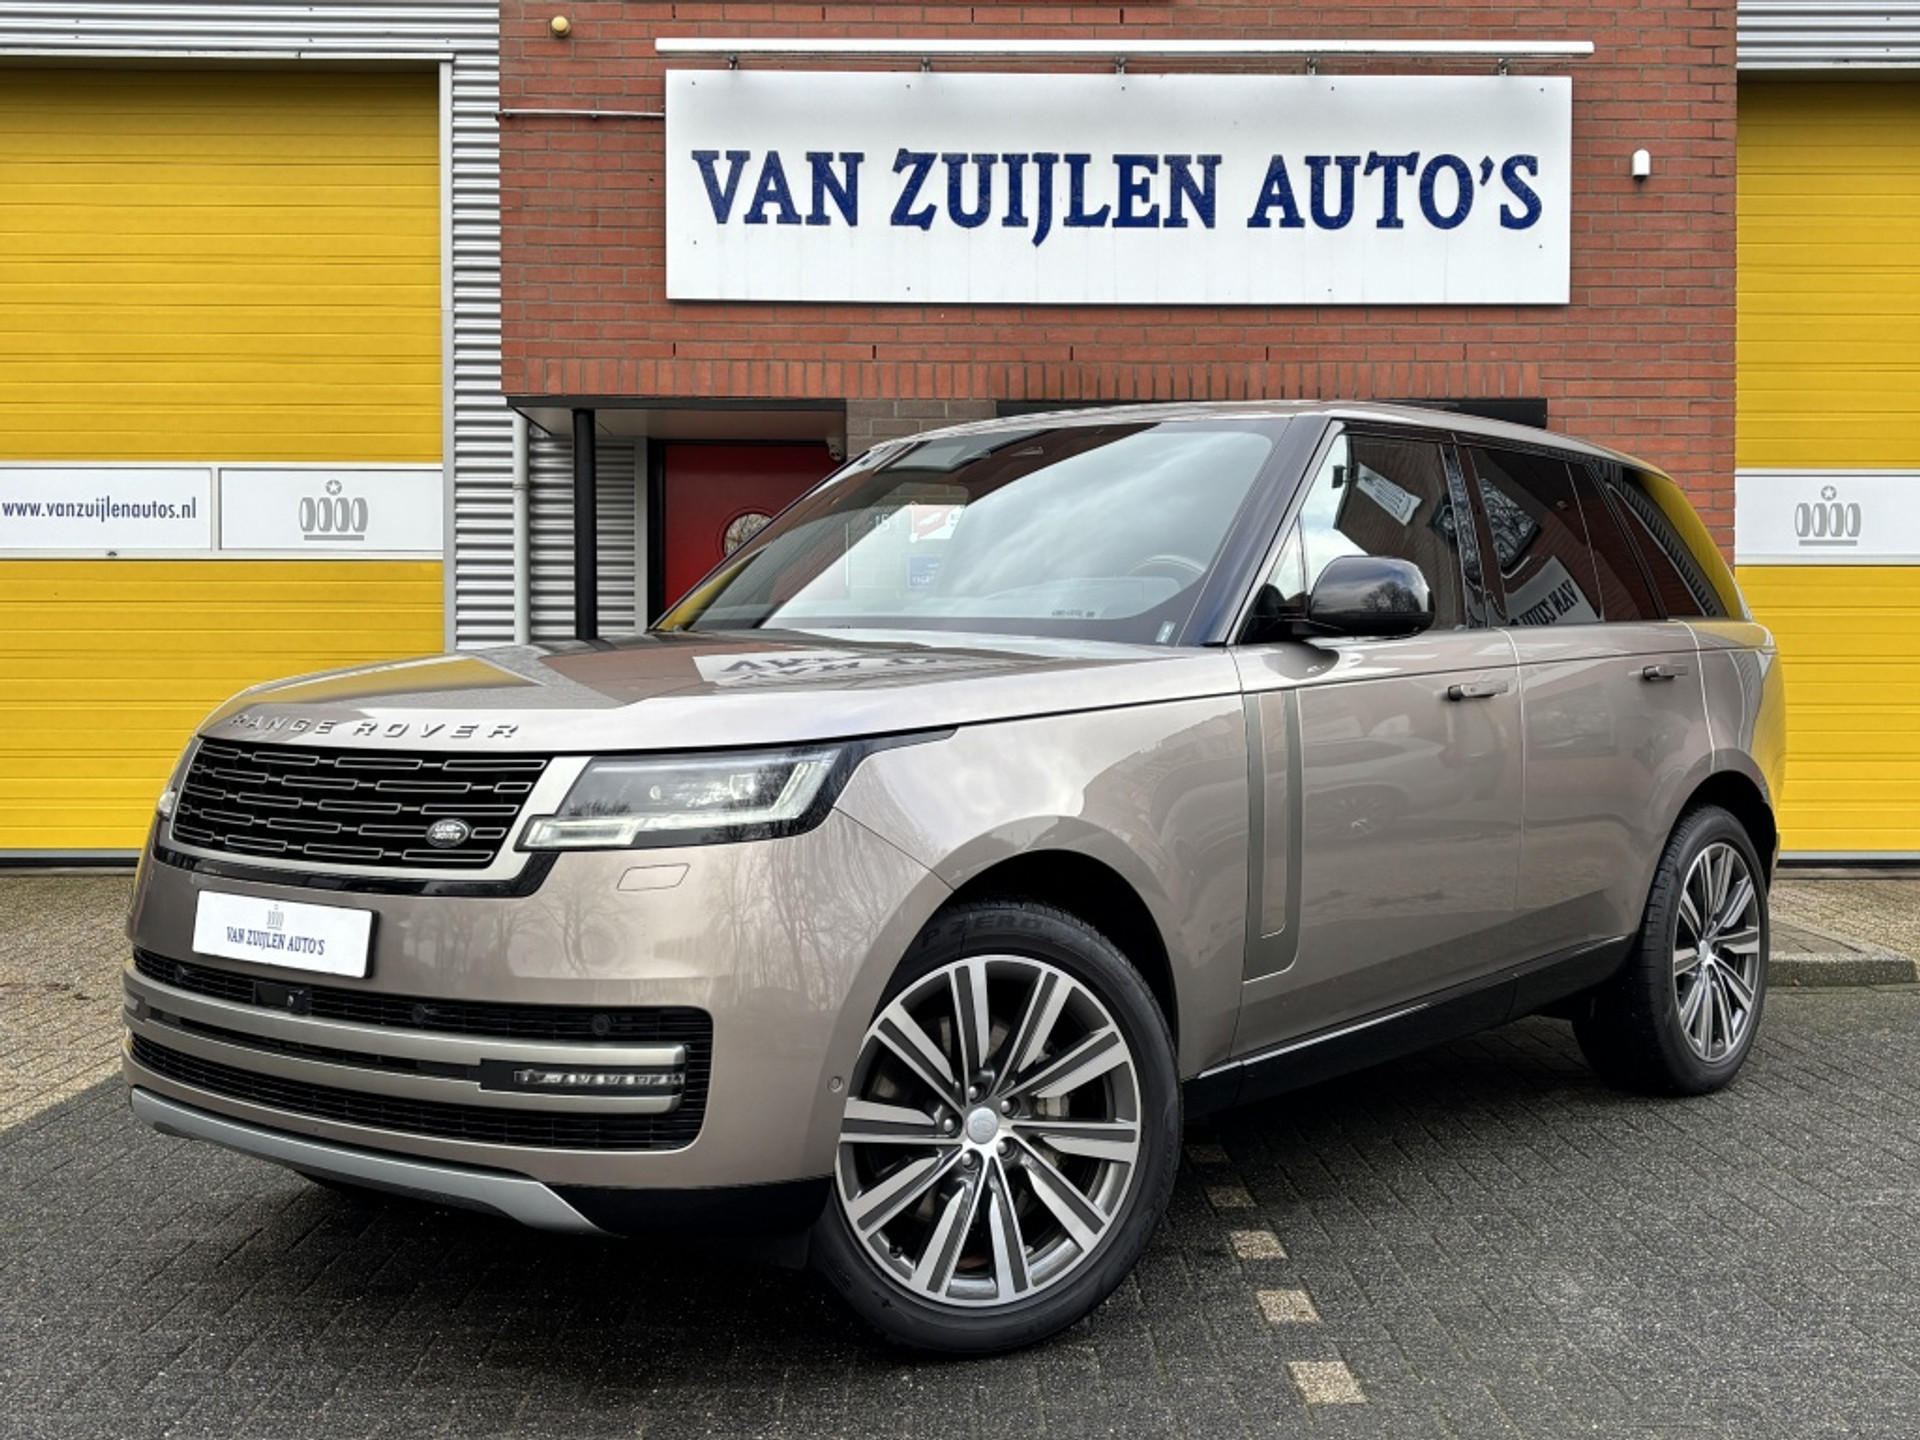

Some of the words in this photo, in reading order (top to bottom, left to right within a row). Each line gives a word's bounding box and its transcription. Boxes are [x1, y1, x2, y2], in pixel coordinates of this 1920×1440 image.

[691, 150, 865, 227] VAN
[890, 147, 1222, 247] ZUIJLEN
[1246, 152, 1543, 231] AUTO'S
[1, 495, 197, 522] www.vanzuijlenautos.nl
[229, 713, 338, 735] RANGE
[353, 722, 519, 739] ROVER
[226, 926, 246, 944] VAN
[246, 929, 287, 951] ZUIJLEN
[286, 936, 326, 956] AUTO'S
